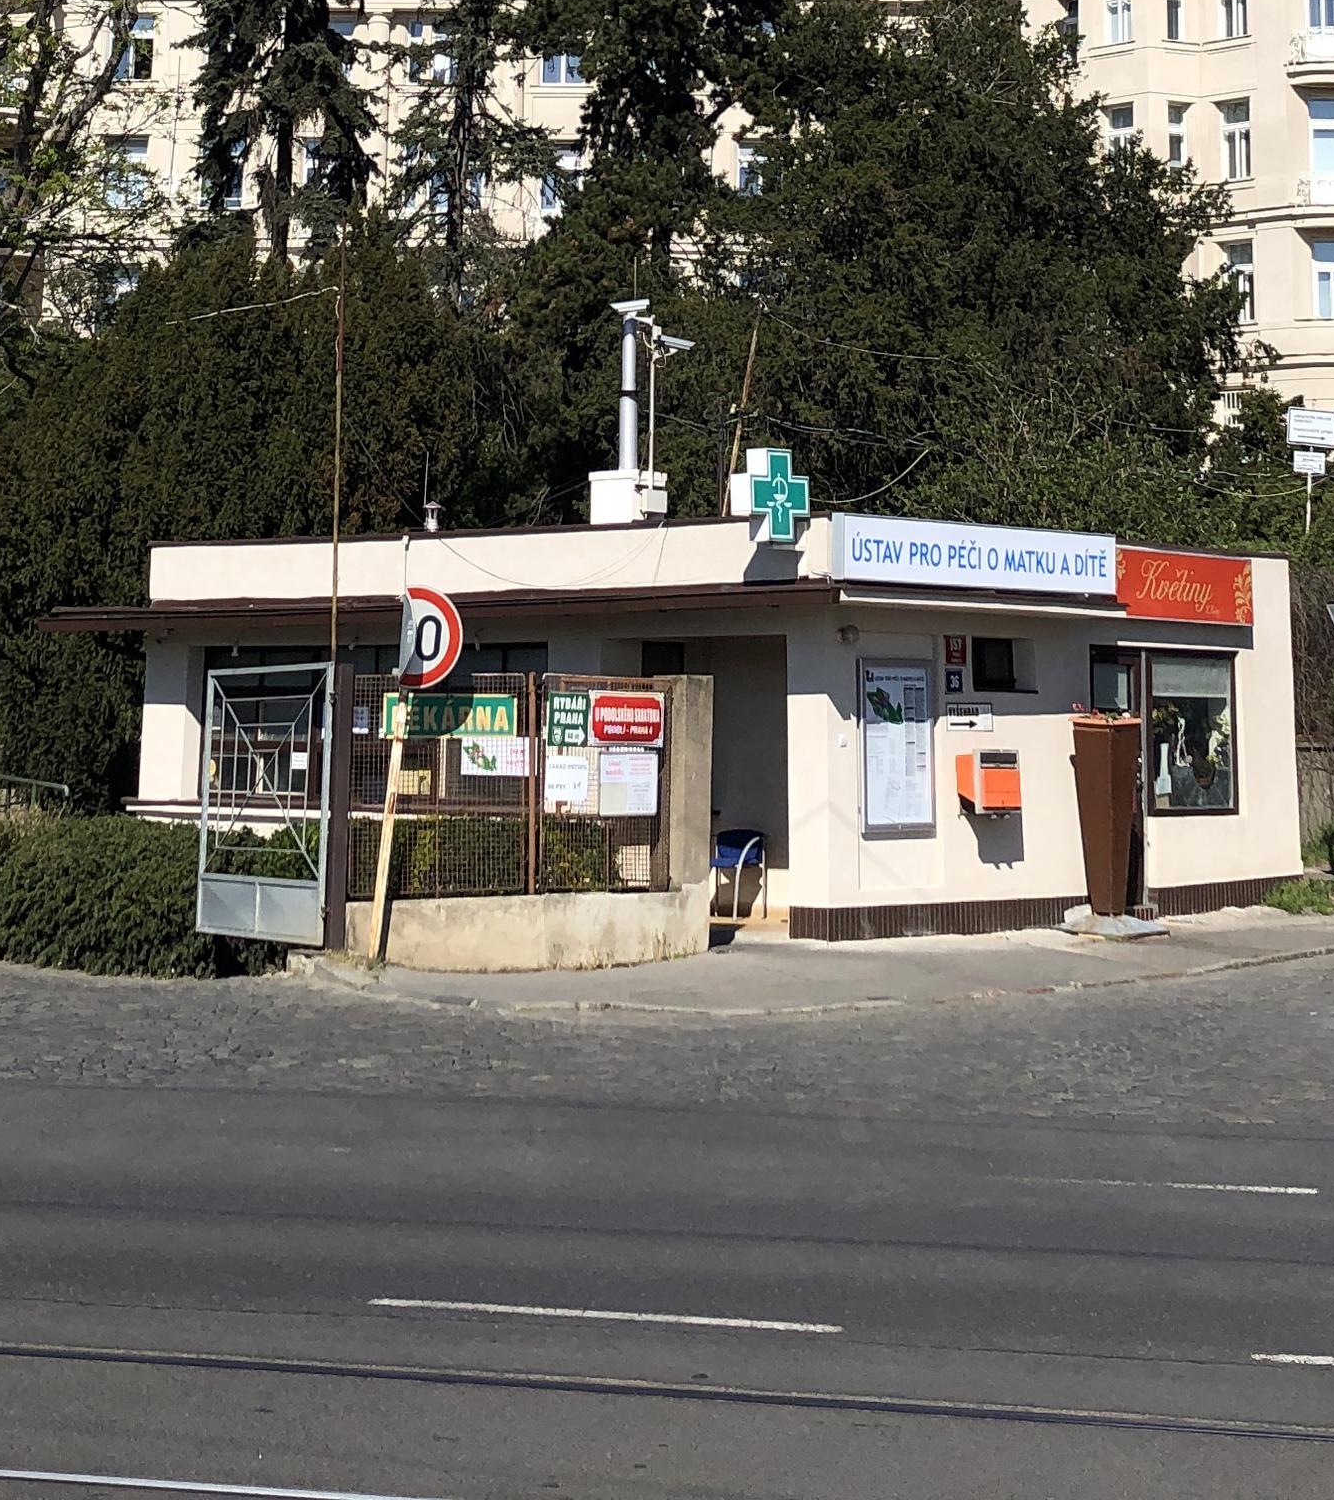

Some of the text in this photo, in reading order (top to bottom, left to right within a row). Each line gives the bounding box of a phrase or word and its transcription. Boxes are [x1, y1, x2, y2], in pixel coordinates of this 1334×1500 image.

[852, 532, 1107, 578] ÚSTAV PRO PÉČI O MATKU A DÍTĚ
[1136, 560, 1212, 613] Květiny
[554, 711, 584, 725] PRAHA
